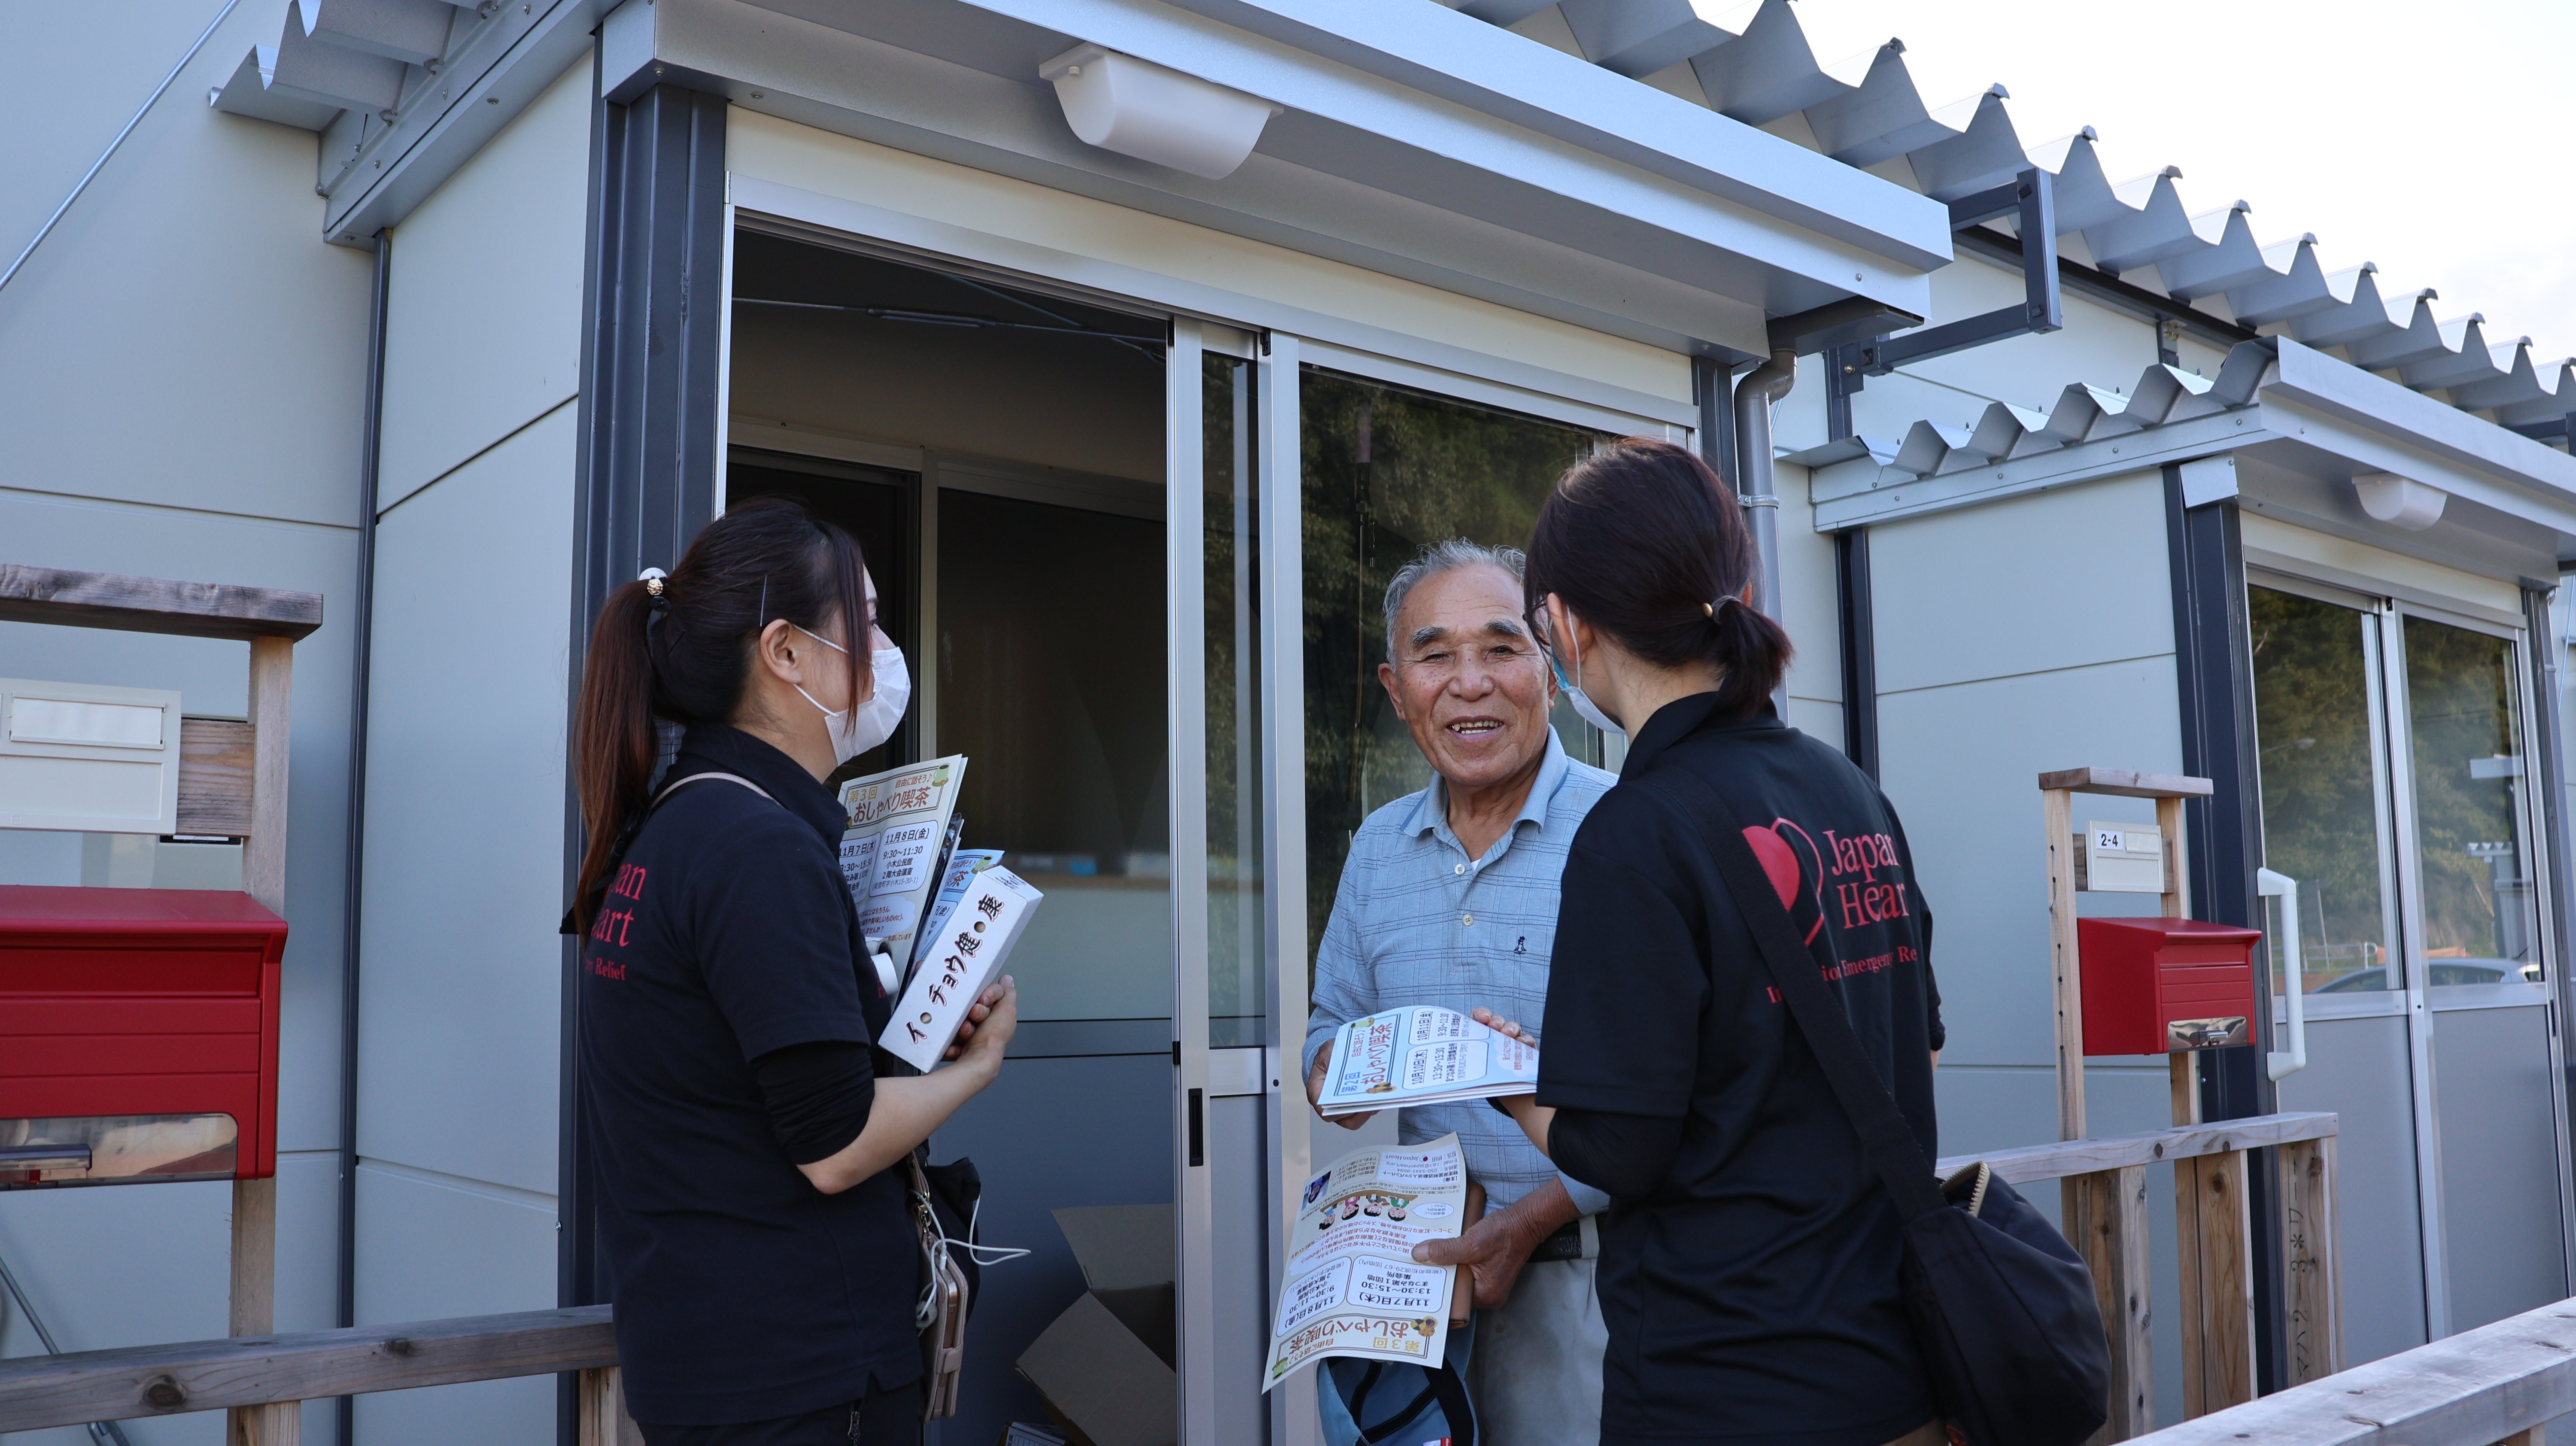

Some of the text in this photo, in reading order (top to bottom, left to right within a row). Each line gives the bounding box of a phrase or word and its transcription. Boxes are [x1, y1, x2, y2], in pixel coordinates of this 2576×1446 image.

[849, 786, 878, 804] 第3回
[854, 786, 931, 823] おしゃべり喫茶
[2101, 833, 2118, 847] 2-4
[1836, 882, 1910, 929] Hear
[595, 957, 626, 981] Relief
[1361, 1023, 1392, 1084] おしゃべり喫茶
[1340, 1071, 1361, 1093] 第2回
[1386, 1271, 1412, 1279] 集会所
[1359, 1292, 1430, 1306] 11月7日(木)
[1285, 1297, 1335, 1328] 11月8日(金)
[1289, 1318, 1409, 1355] おしゃべり喫茶
[1373, 1337, 1420, 1352] 第3回
